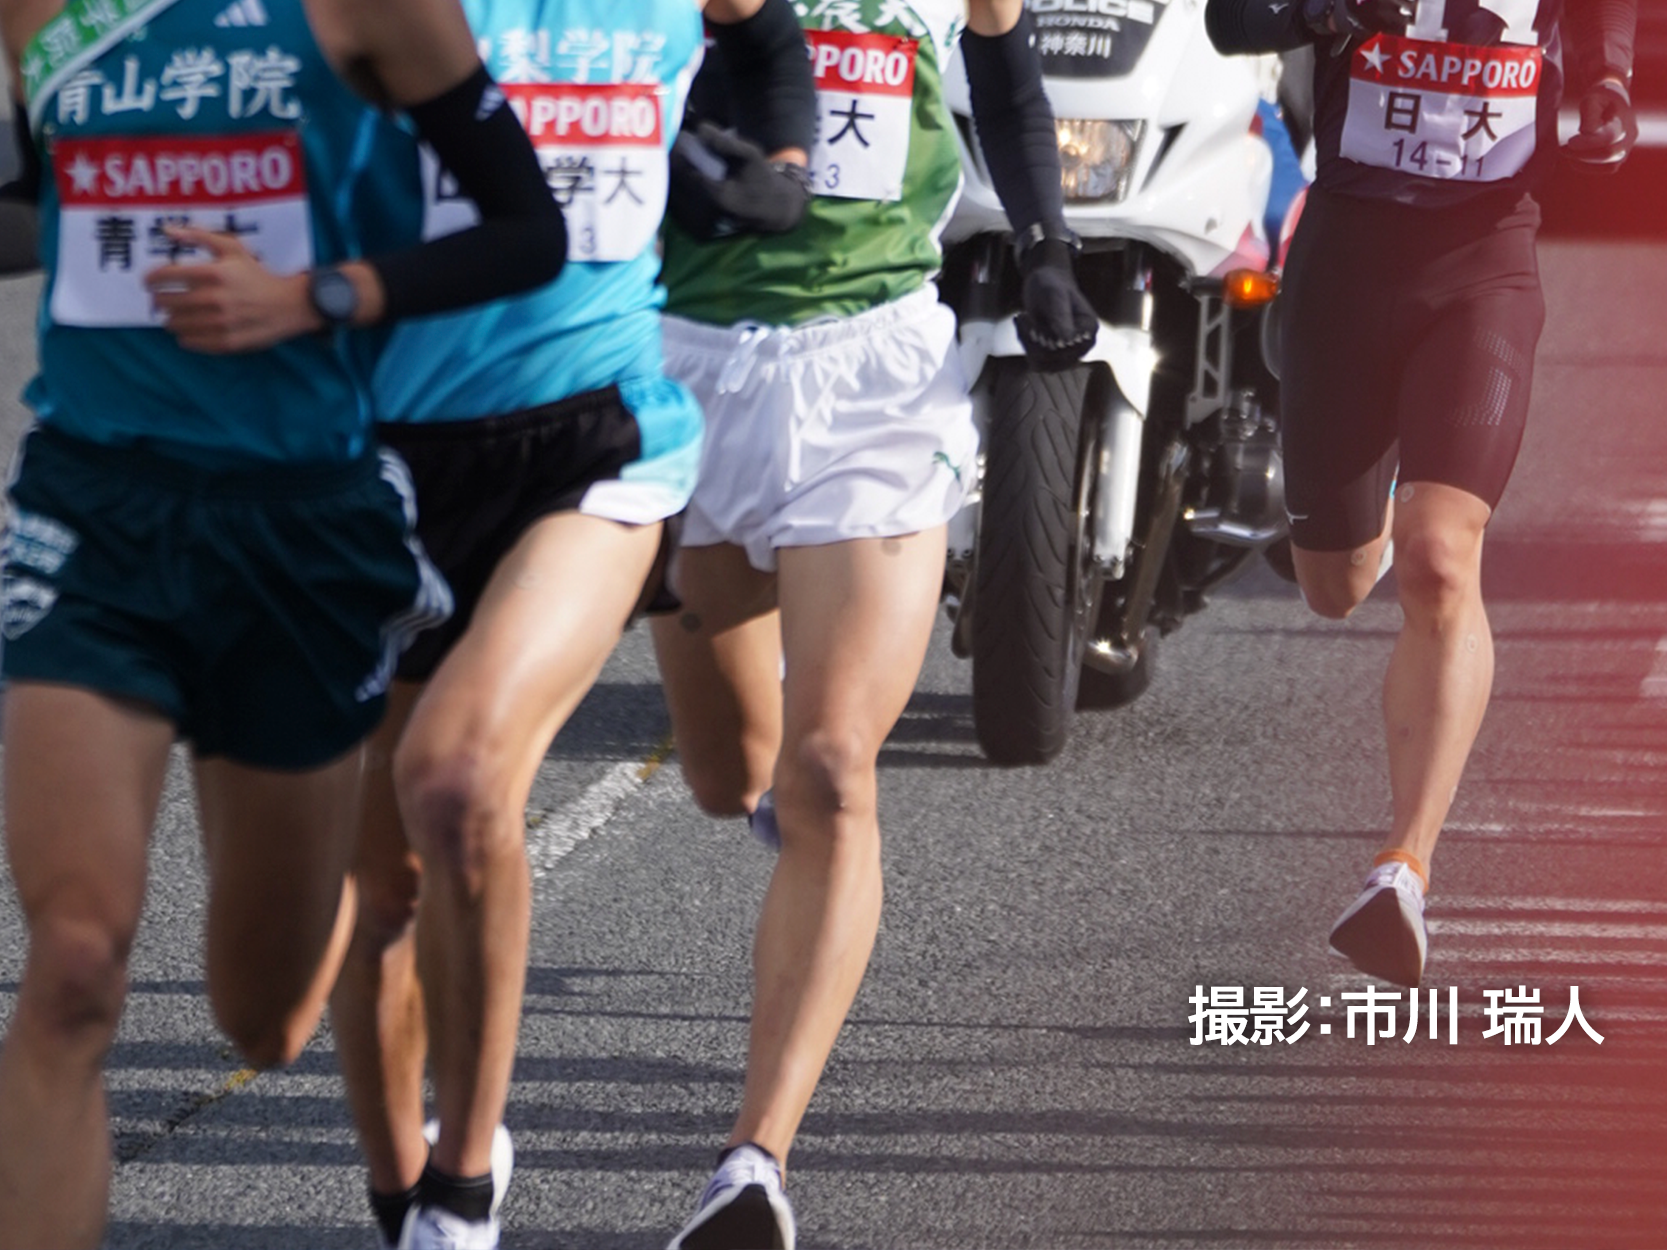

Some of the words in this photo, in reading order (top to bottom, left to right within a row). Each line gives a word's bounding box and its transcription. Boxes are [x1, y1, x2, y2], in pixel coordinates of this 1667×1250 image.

[1036, 13, 1121, 33] HONDA
[805, 43, 909, 87] PORO
[1040, 30, 1113, 60] 神奈川
[56, 46, 303, 125] 青山学院
[1397, 49, 1537, 89] SAPPORO
[103, 146, 292, 198] SAPPORO
[1392, 137, 1485, 178] 14-11
